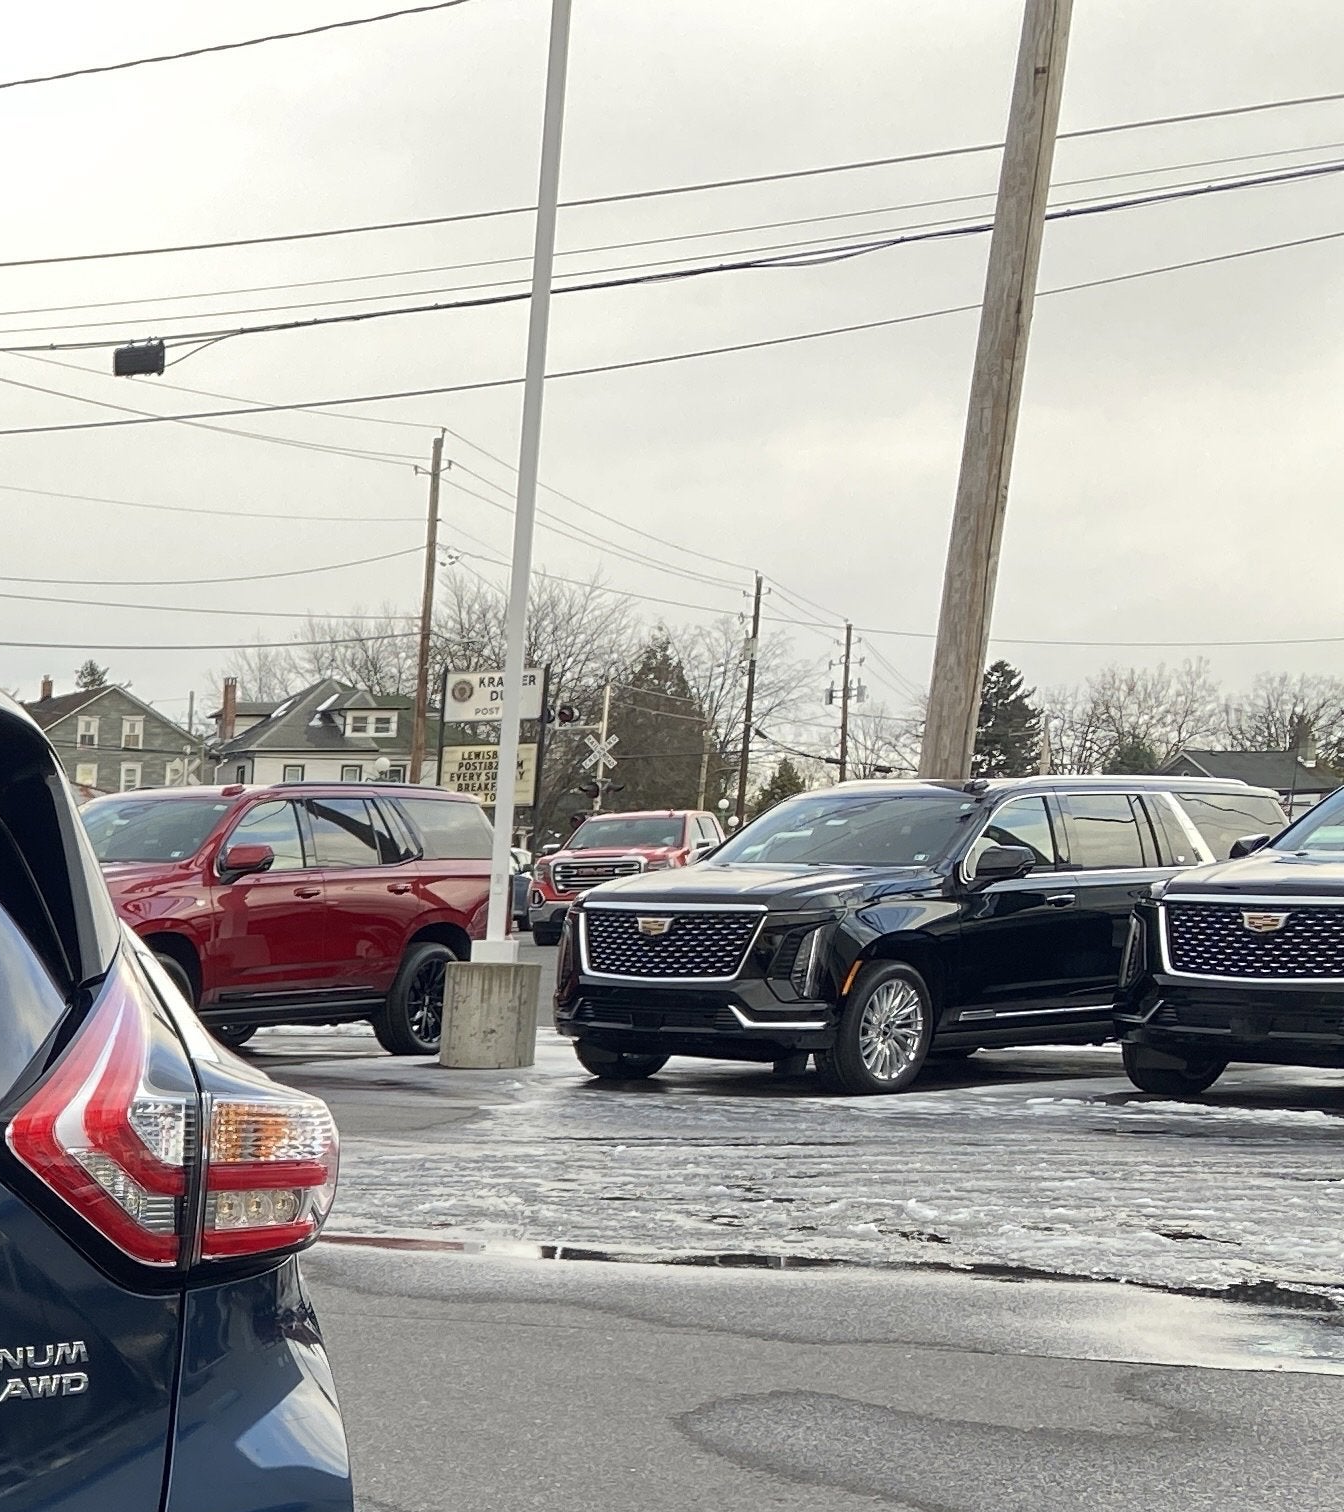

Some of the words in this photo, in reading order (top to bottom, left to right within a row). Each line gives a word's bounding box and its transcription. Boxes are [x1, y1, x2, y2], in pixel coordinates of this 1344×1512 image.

[478, 674, 536, 688] KRAER
[475, 706, 500, 716] POST
[461, 750, 519, 761] LEWISB
[449, 772, 482, 782] EVERY
